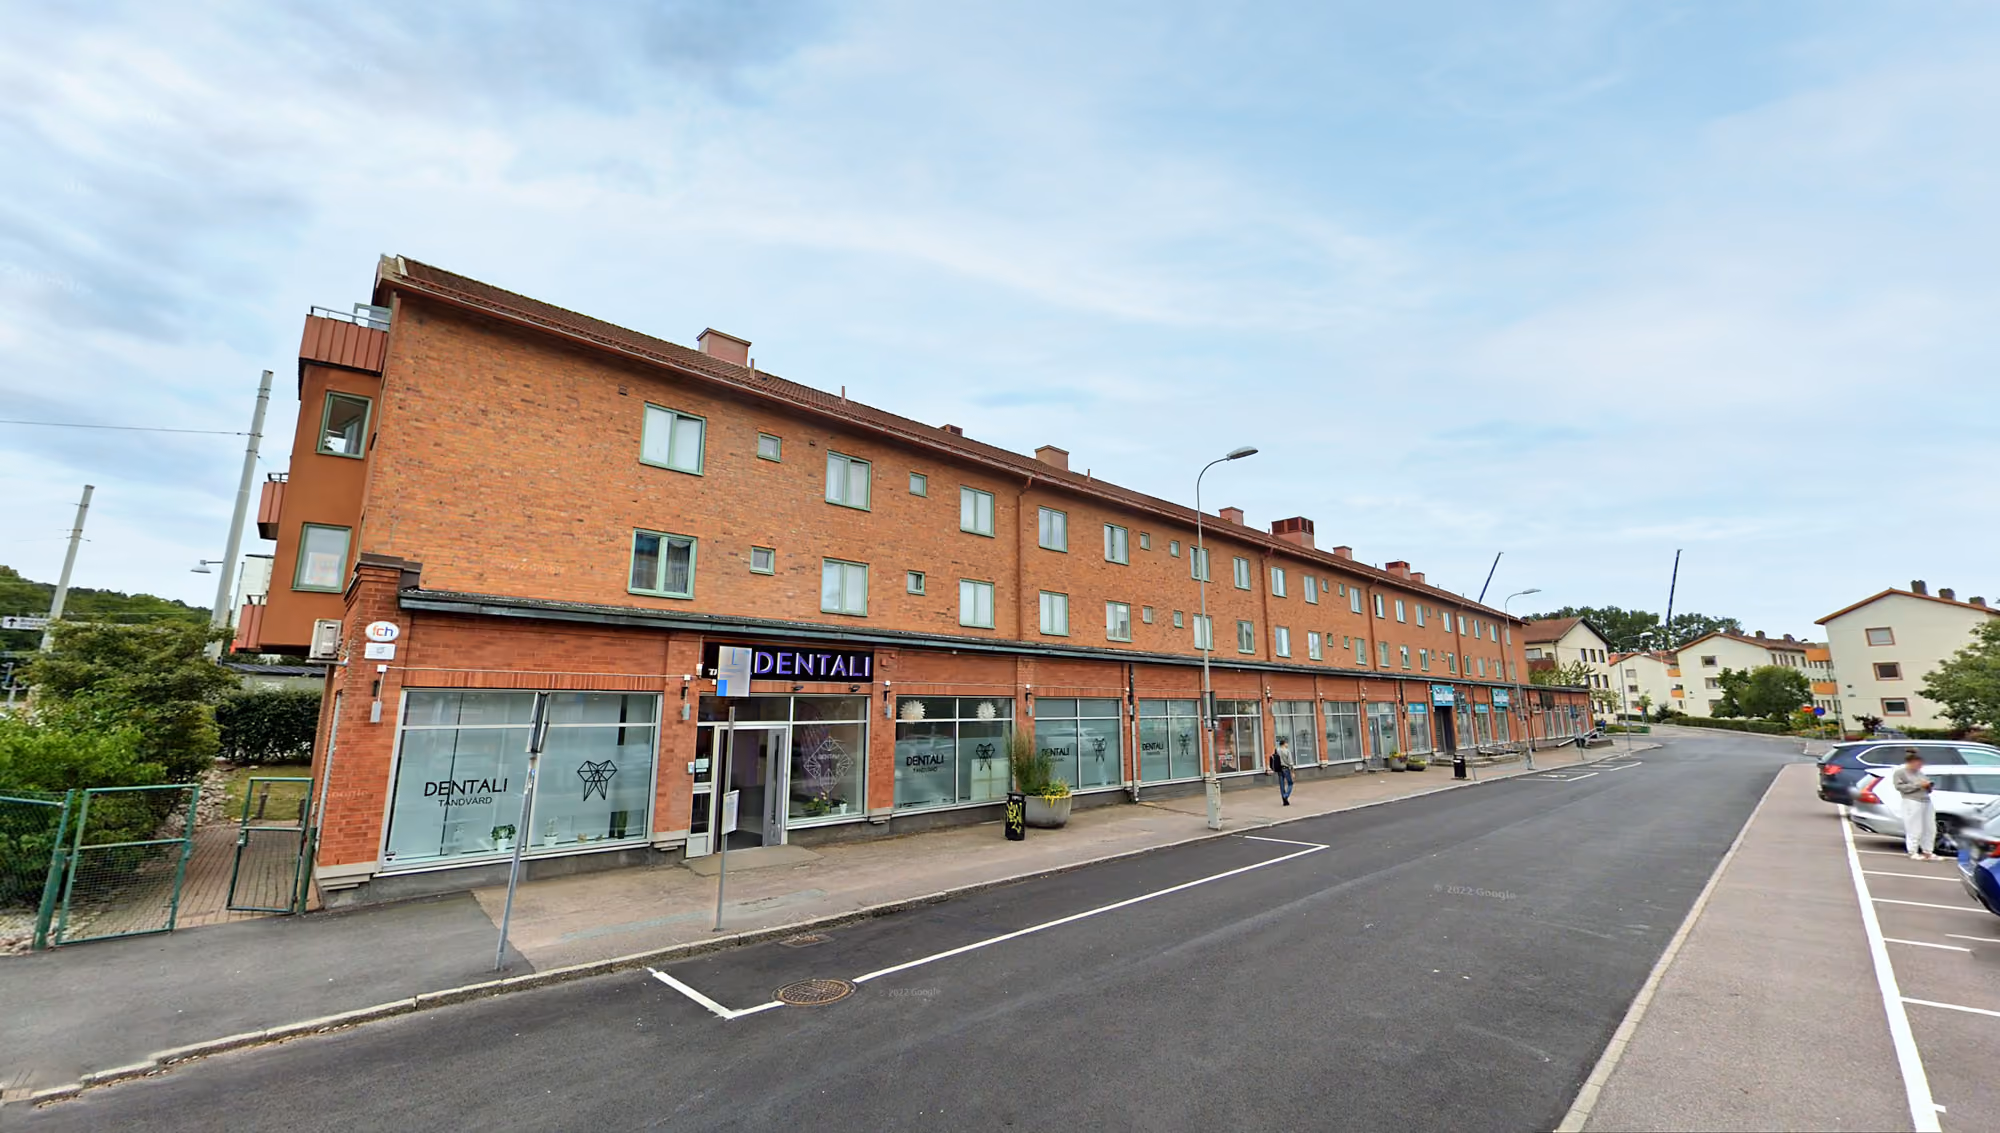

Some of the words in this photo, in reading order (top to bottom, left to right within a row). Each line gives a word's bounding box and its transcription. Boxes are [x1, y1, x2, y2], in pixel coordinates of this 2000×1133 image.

[754, 651, 871, 677] DENTALI
[906, 754, 944, 766] DENTALI
[423, 778, 508, 797] DENTALI
